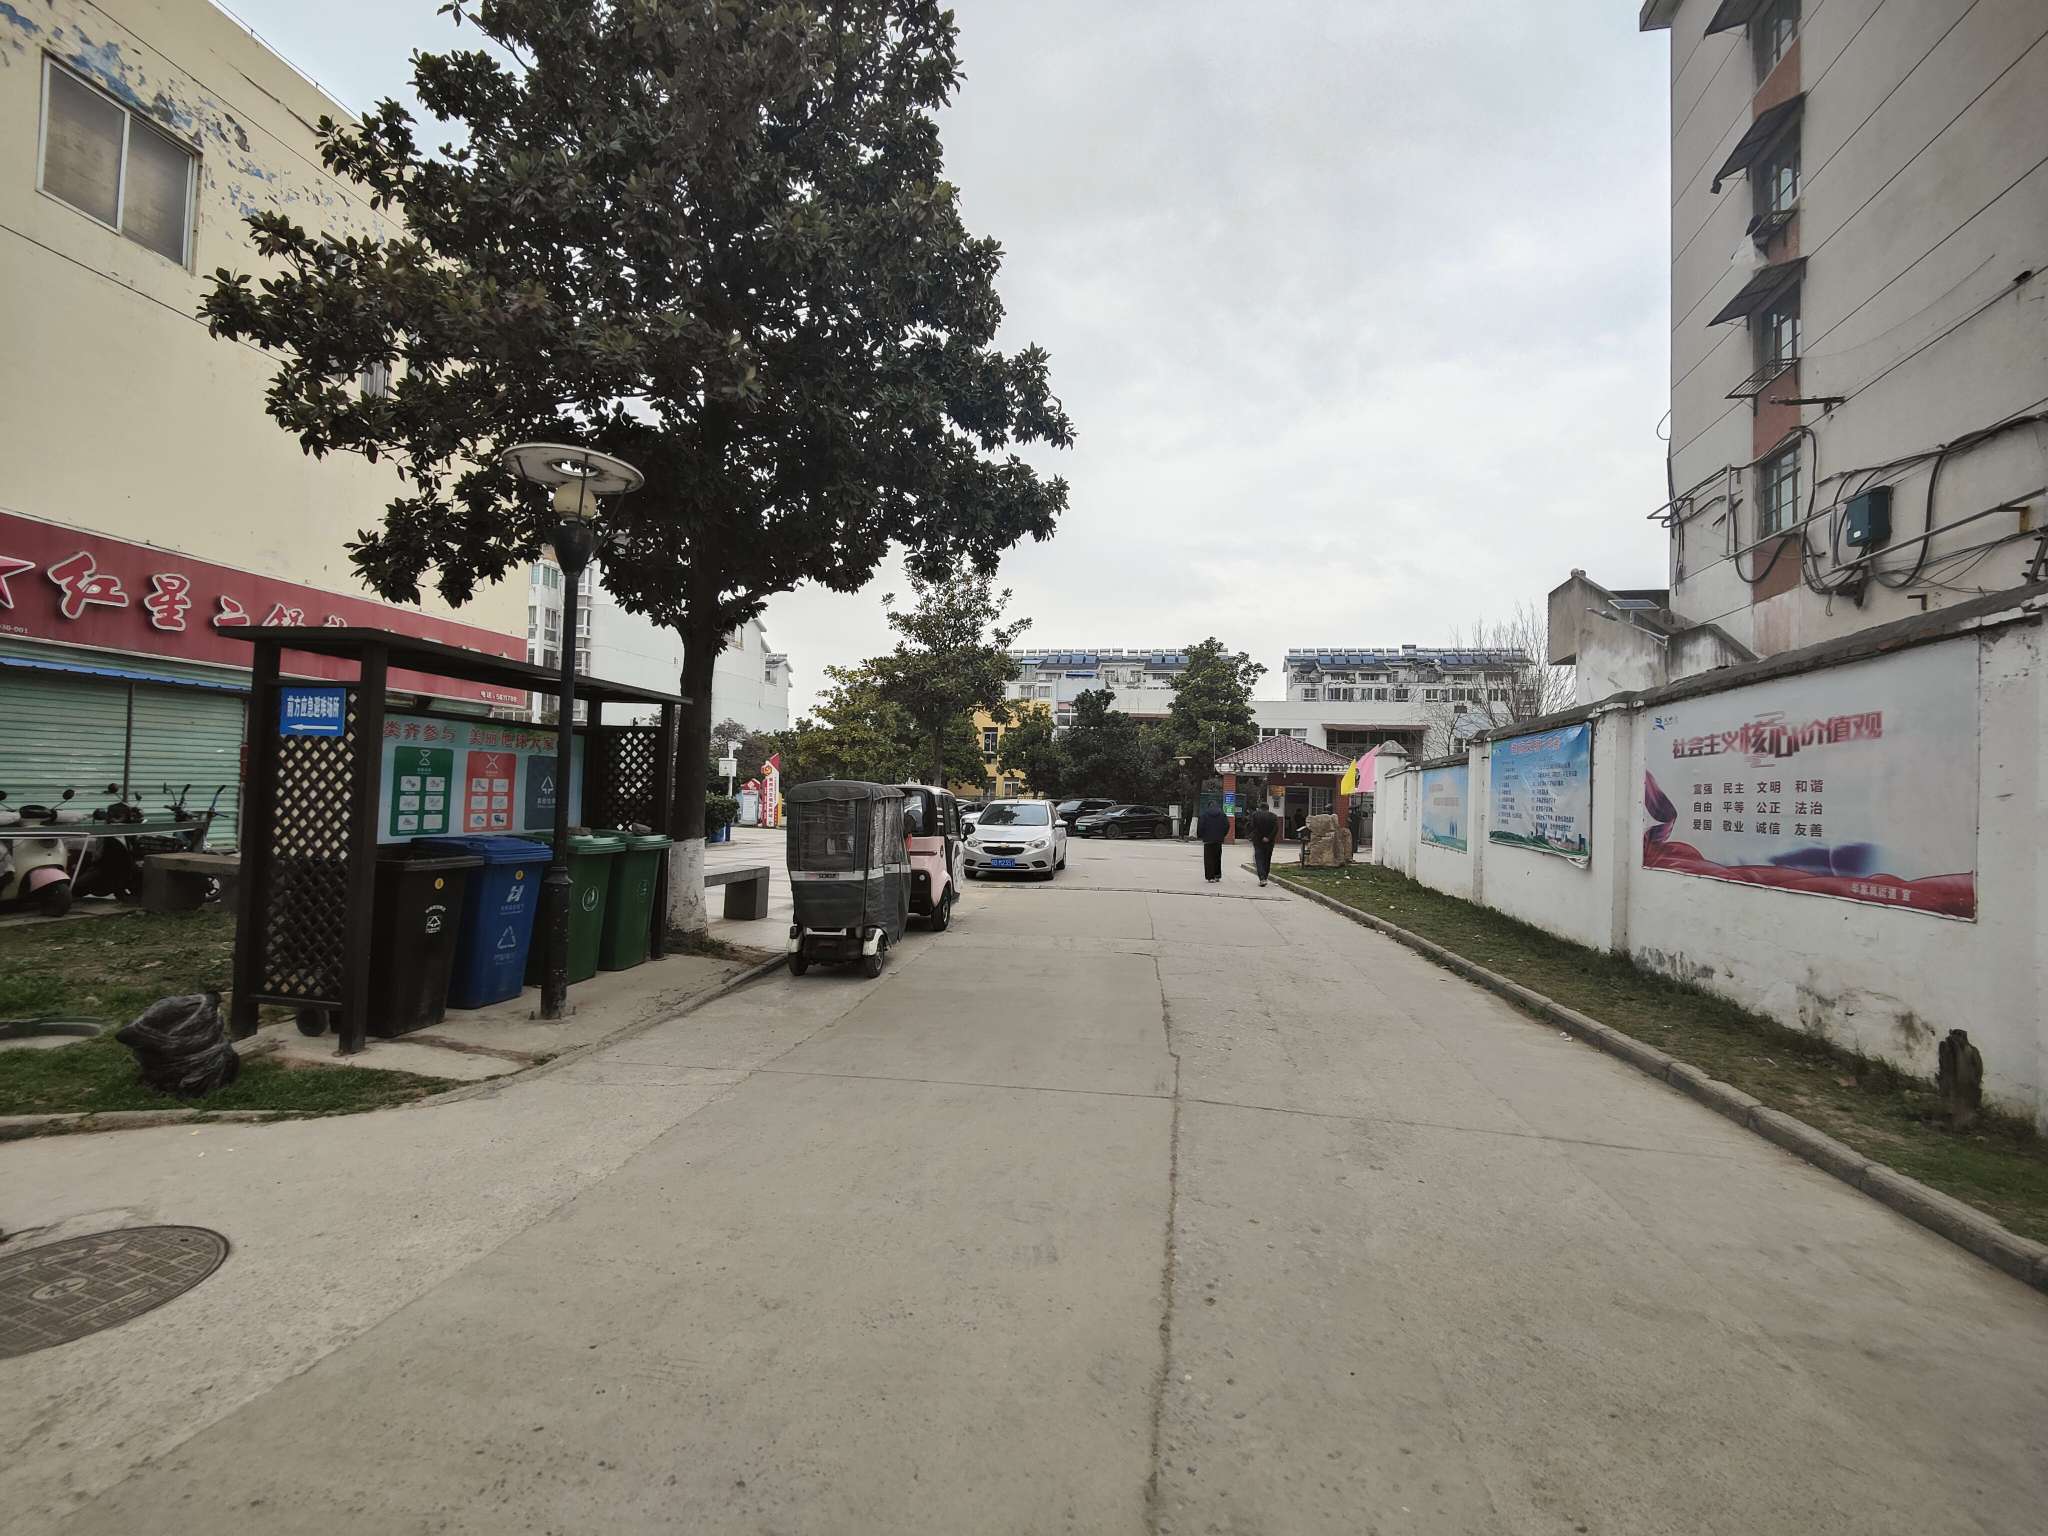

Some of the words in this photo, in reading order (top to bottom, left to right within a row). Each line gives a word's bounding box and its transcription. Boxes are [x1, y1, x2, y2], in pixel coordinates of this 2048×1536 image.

[286, 695, 340, 718] 前方应急避难场所
[1672, 710, 1884, 760] 社会主义核心价值观
[1693, 783, 1713, 795] 富强
[1723, 782, 1745, 794] 民主
[1756, 781, 1781, 794] 文明
[1795, 779, 1824, 793] 和谐
[1693, 802, 1712, 813] 自由
[1722, 801, 1744, 814] 平等
[1756, 801, 1781, 814] 公正
[1795, 801, 1823, 815] 法治
[1693, 819, 1712, 831] 爱国
[1722, 820, 1745, 833] 敬业
[1756, 822, 1781, 835] 诚信
[1794, 822, 1823, 838] 友善
